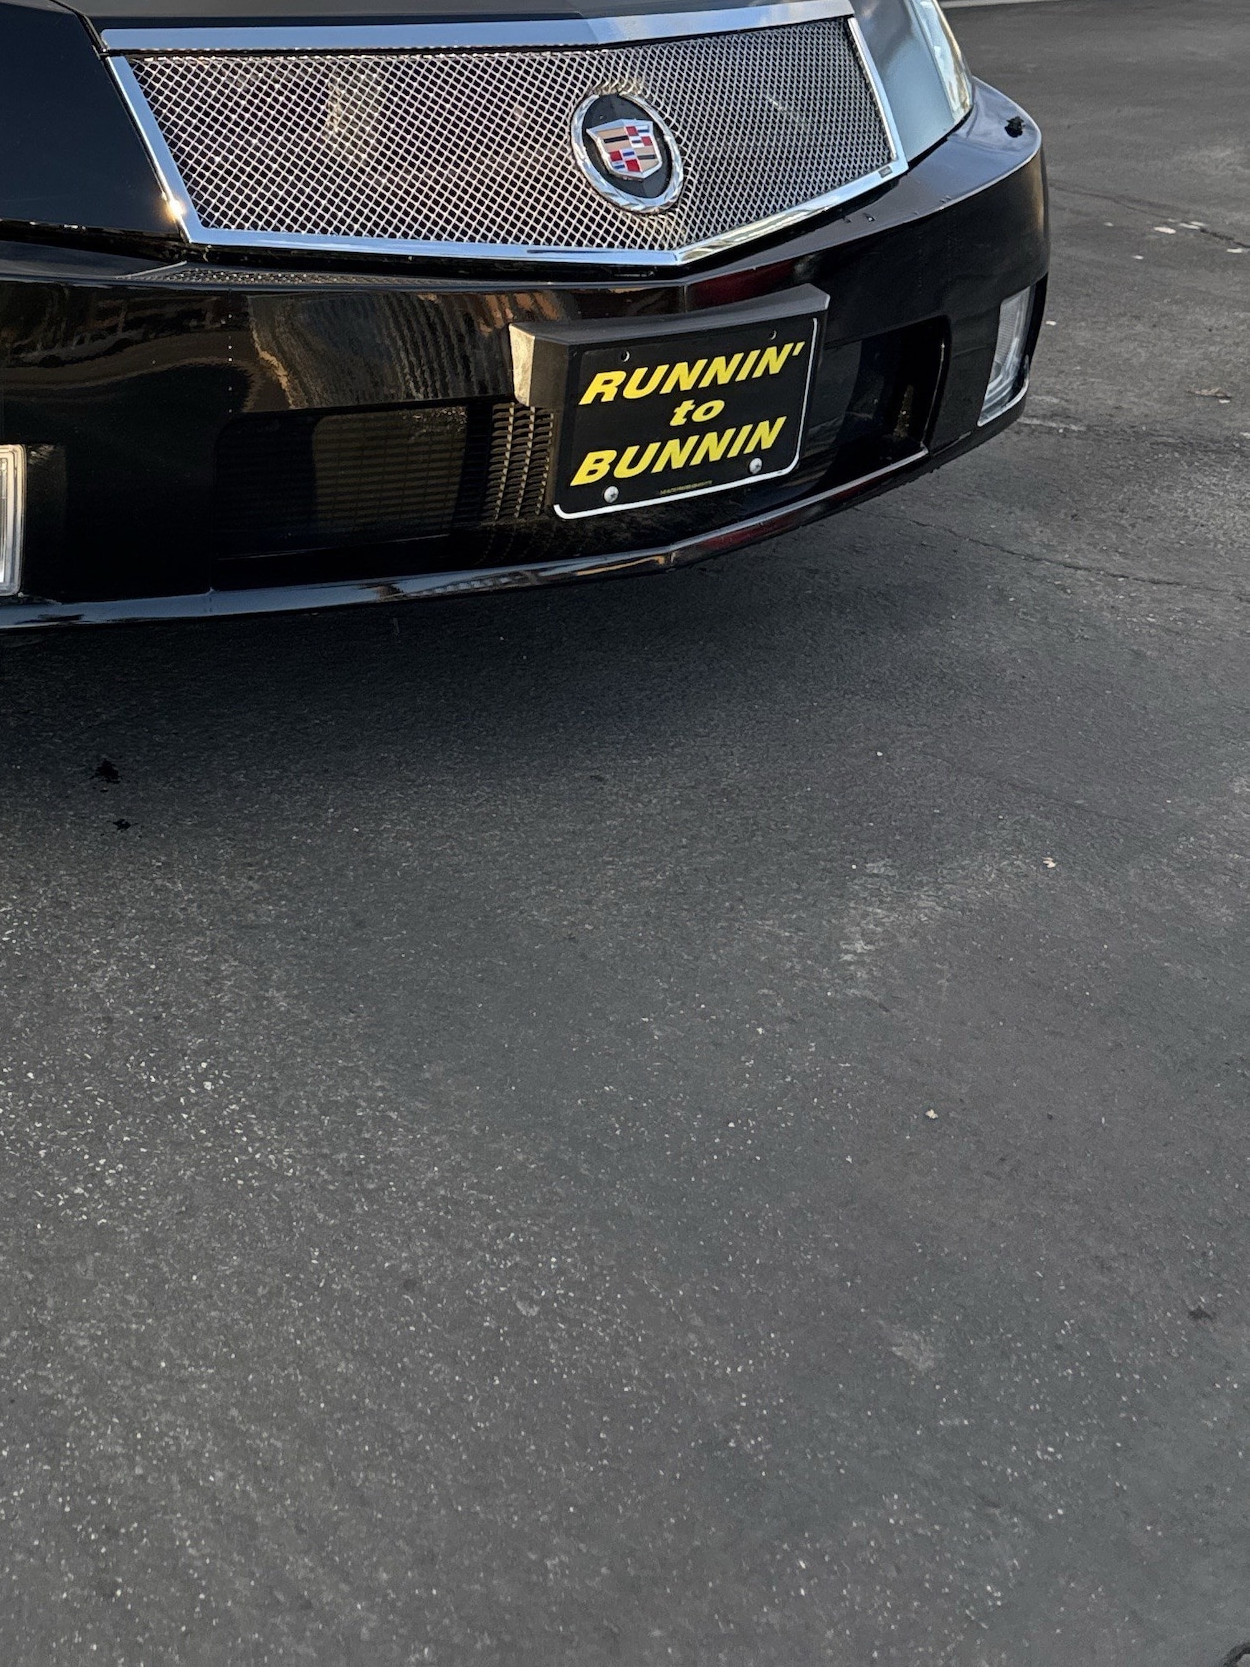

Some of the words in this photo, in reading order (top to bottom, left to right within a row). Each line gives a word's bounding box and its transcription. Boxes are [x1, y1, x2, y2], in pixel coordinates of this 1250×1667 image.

[579, 341, 805, 405] RUNNIN'
[669, 399, 725, 426] to
[570, 416, 787, 486] BUNNIN
